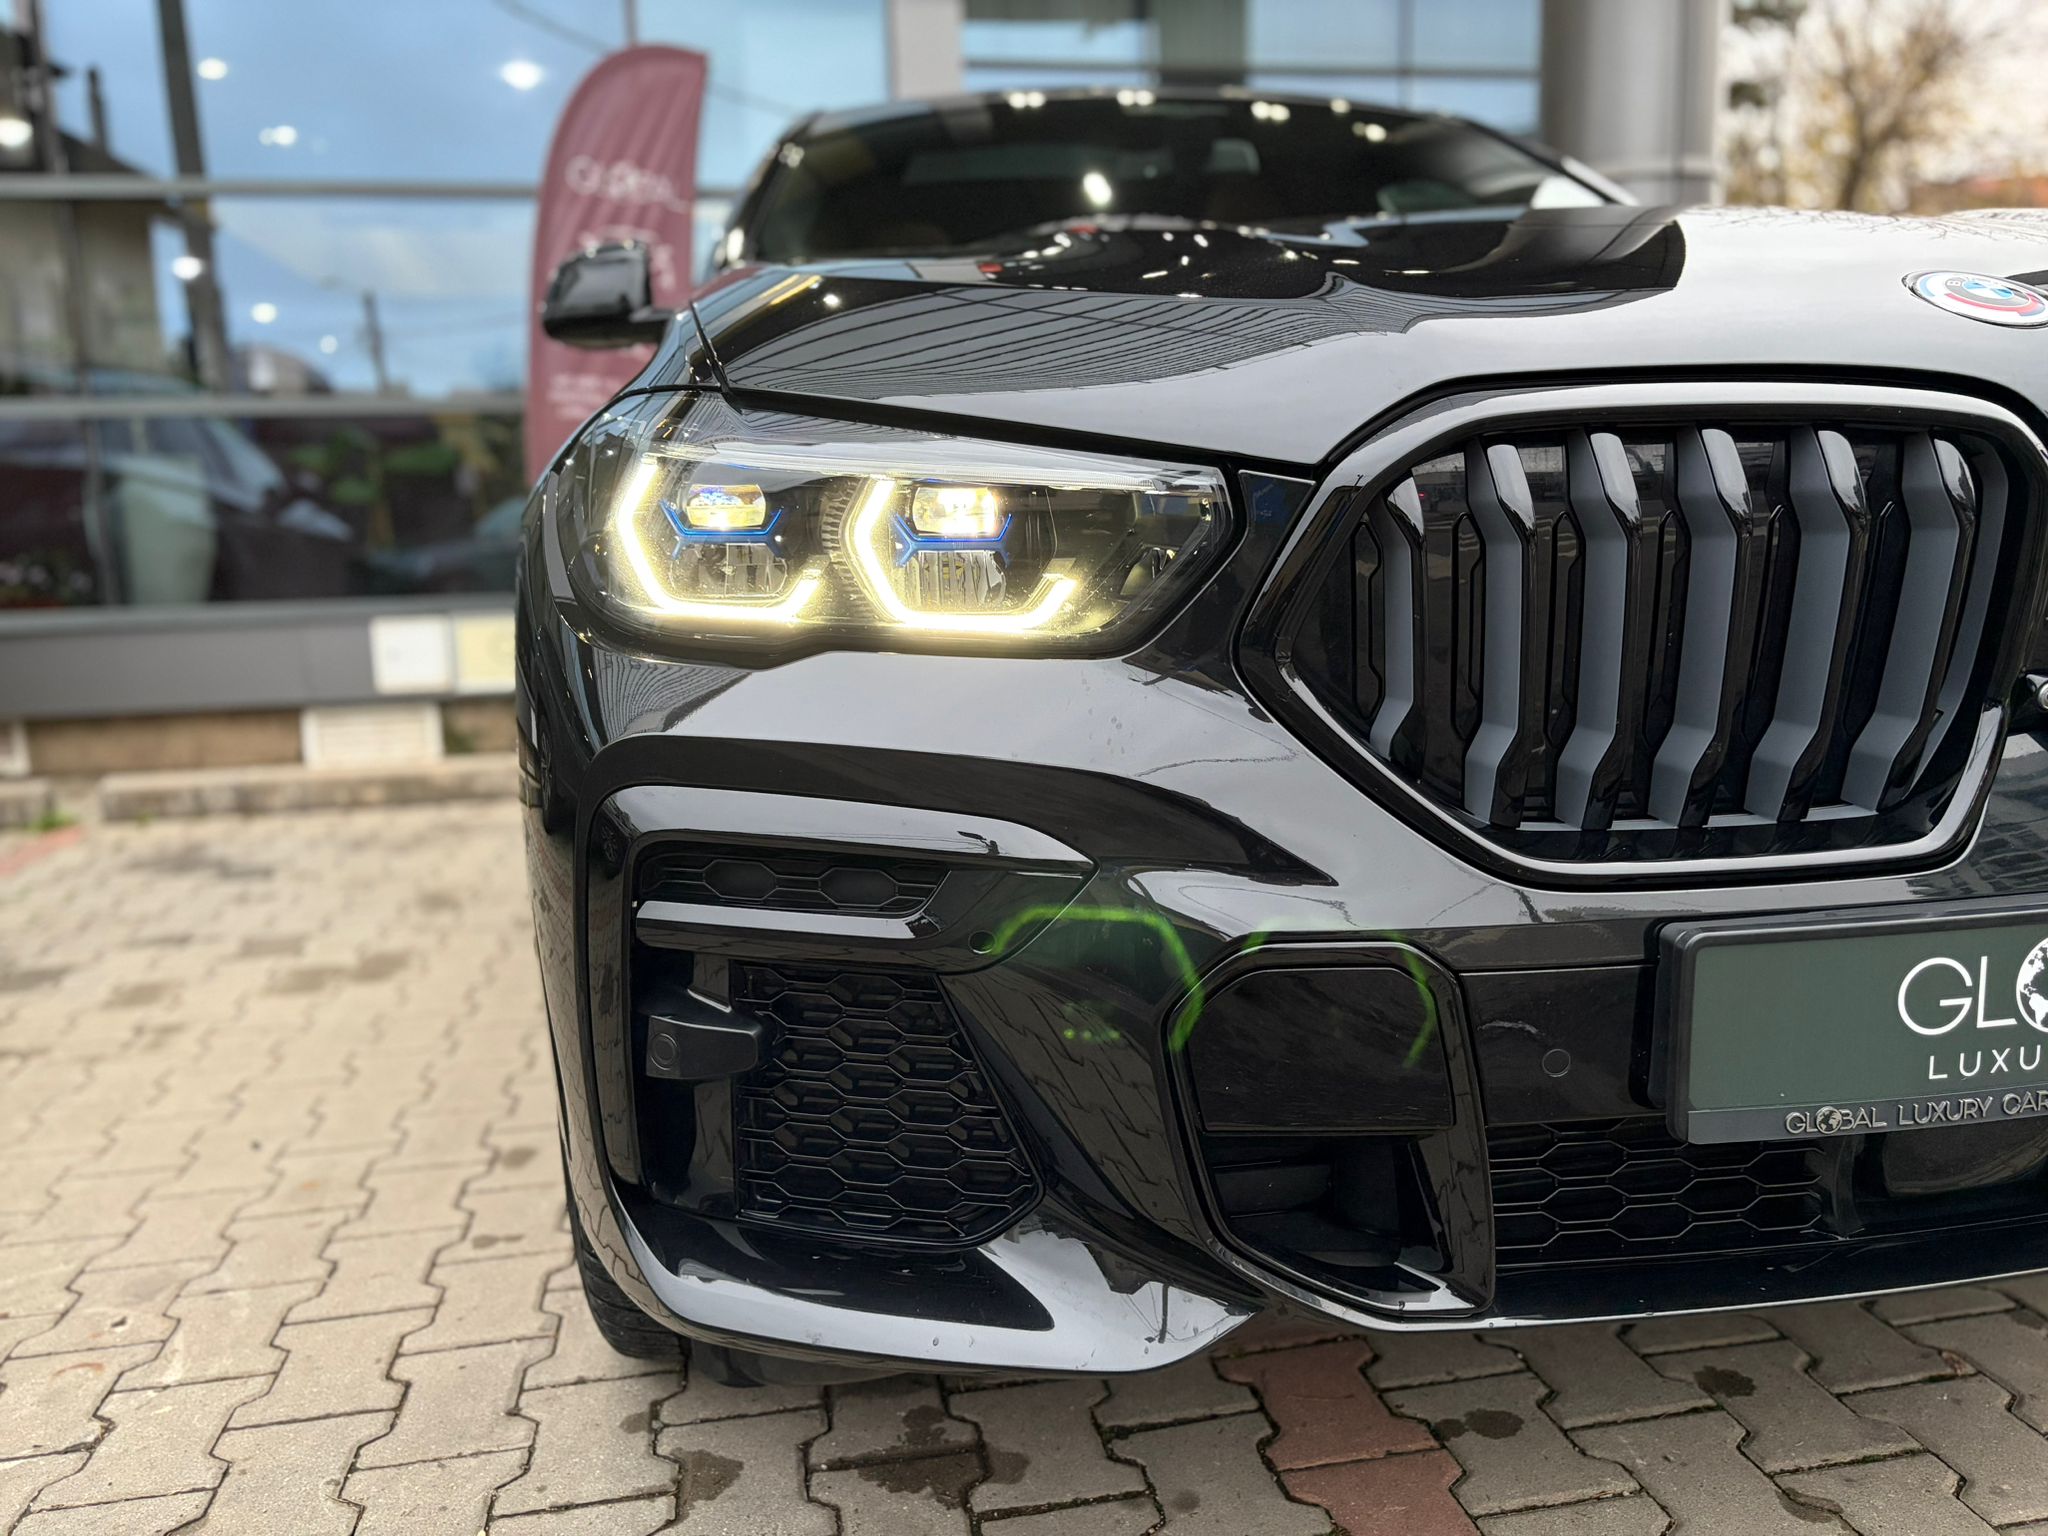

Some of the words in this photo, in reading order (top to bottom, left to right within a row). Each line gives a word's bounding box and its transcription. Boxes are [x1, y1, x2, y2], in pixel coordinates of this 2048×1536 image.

[1928, 1044, 2041, 1079] LUXU
[1785, 1106, 1887, 1134] GLOBAL
[1897, 1095, 1993, 1125] LUXURY
